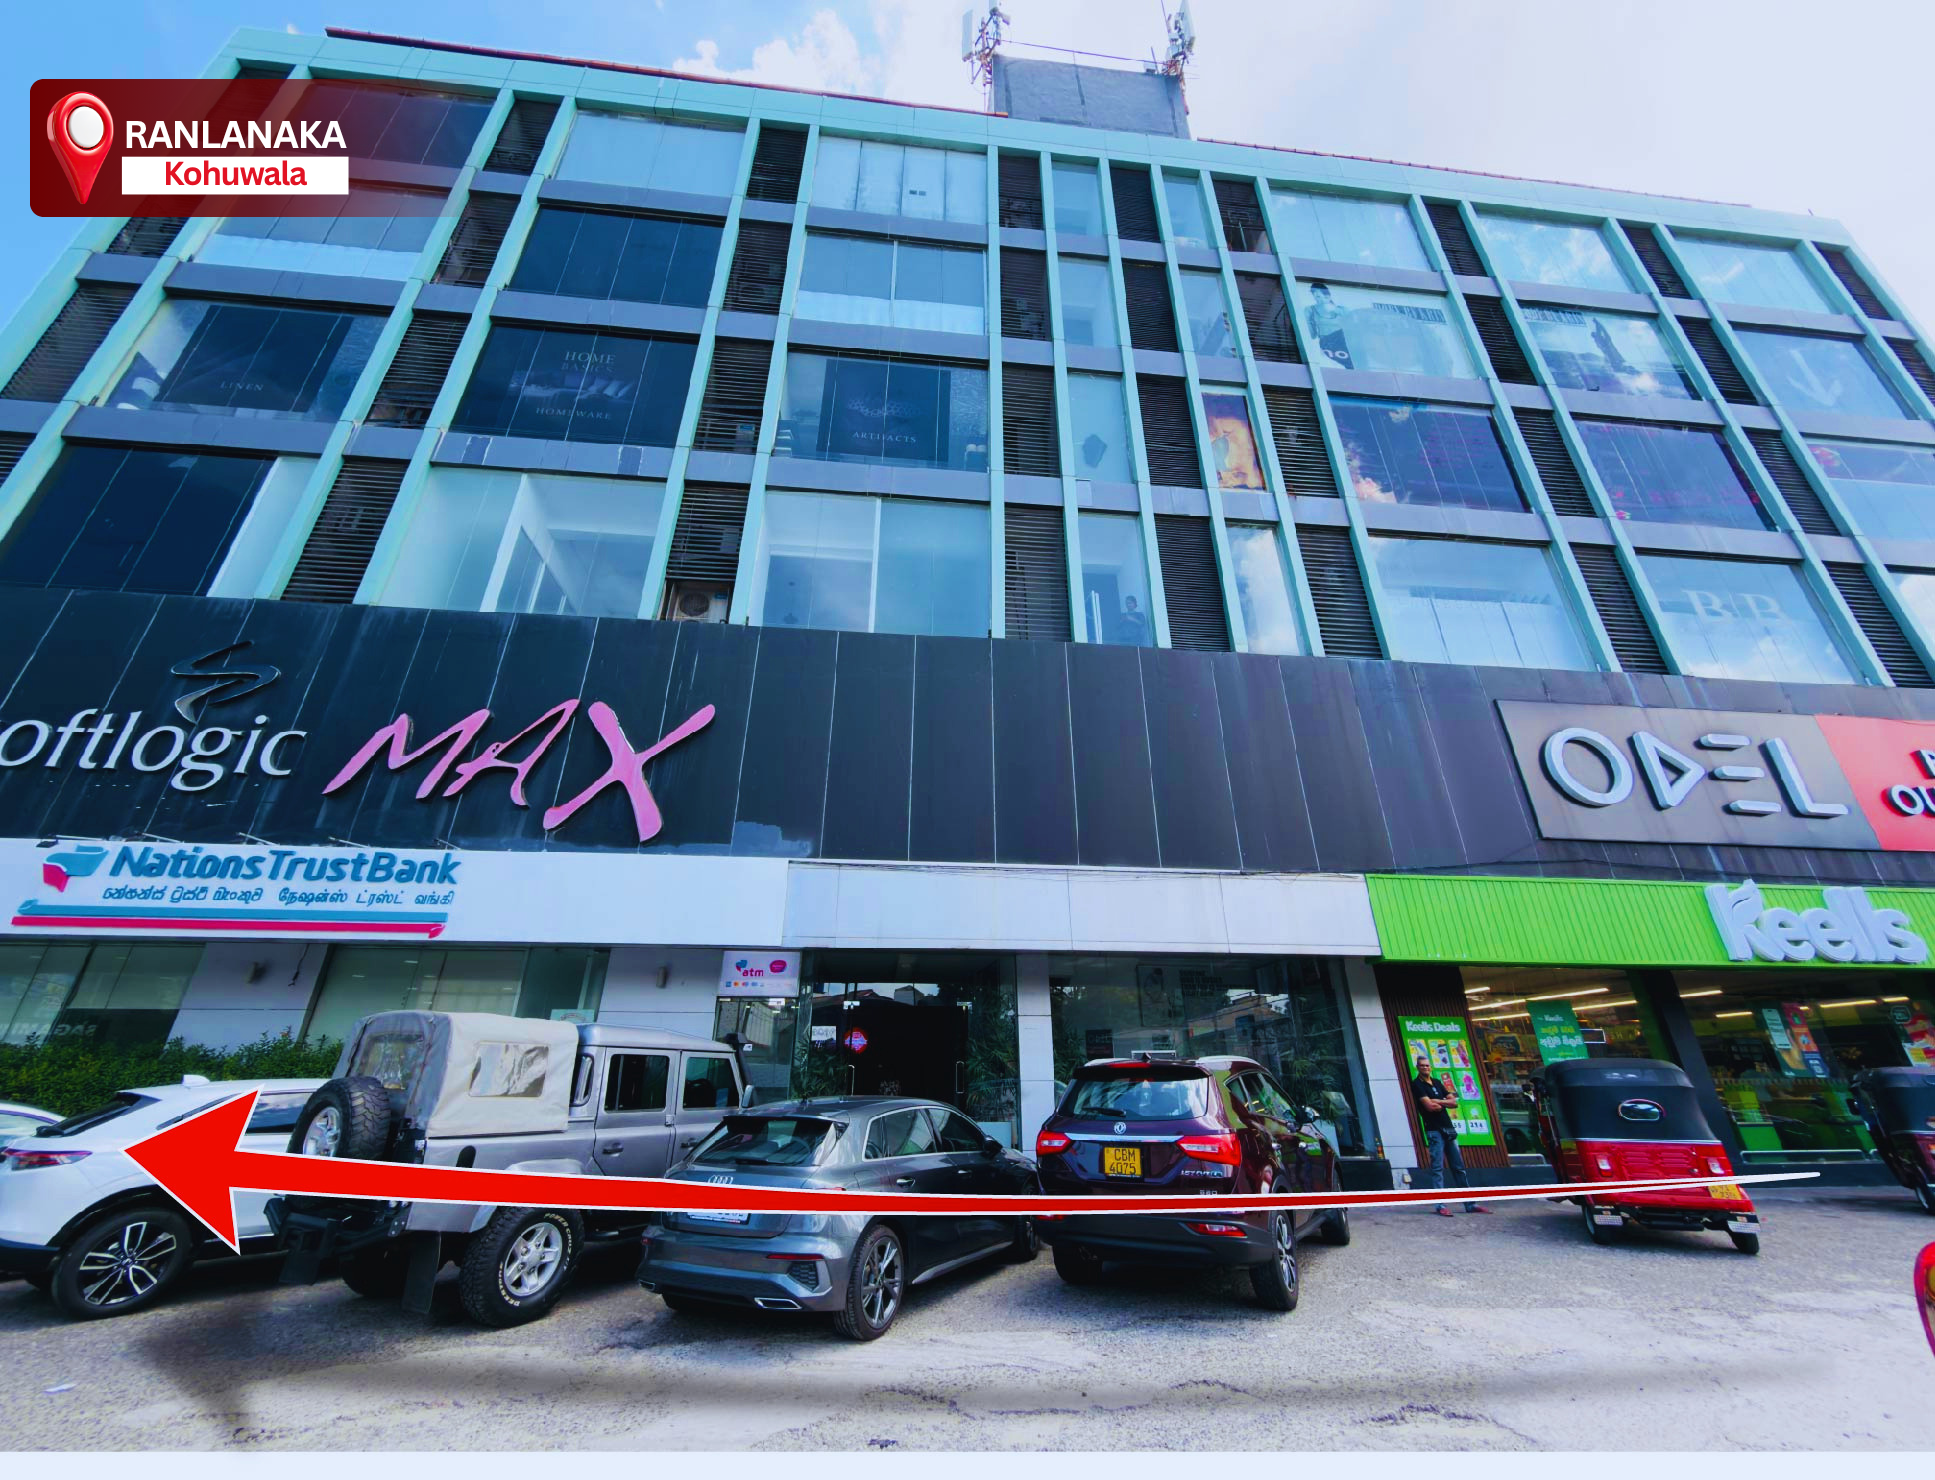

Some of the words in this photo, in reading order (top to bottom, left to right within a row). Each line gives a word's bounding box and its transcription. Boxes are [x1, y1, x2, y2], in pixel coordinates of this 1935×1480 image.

[564, 351, 617, 364] HOME
[219, 380, 264, 392] LINEN
[535, 407, 612, 420] HOMEWARE
[852, 431, 917, 443] ARTIFACTS
[322, 698, 716, 843] MAX
[1705, 878, 1928, 964] Keells
[742, 967, 764, 977] atm
[1114, 1148, 1136, 1161] CBM
[1109, 1162, 1137, 1175] 4075
